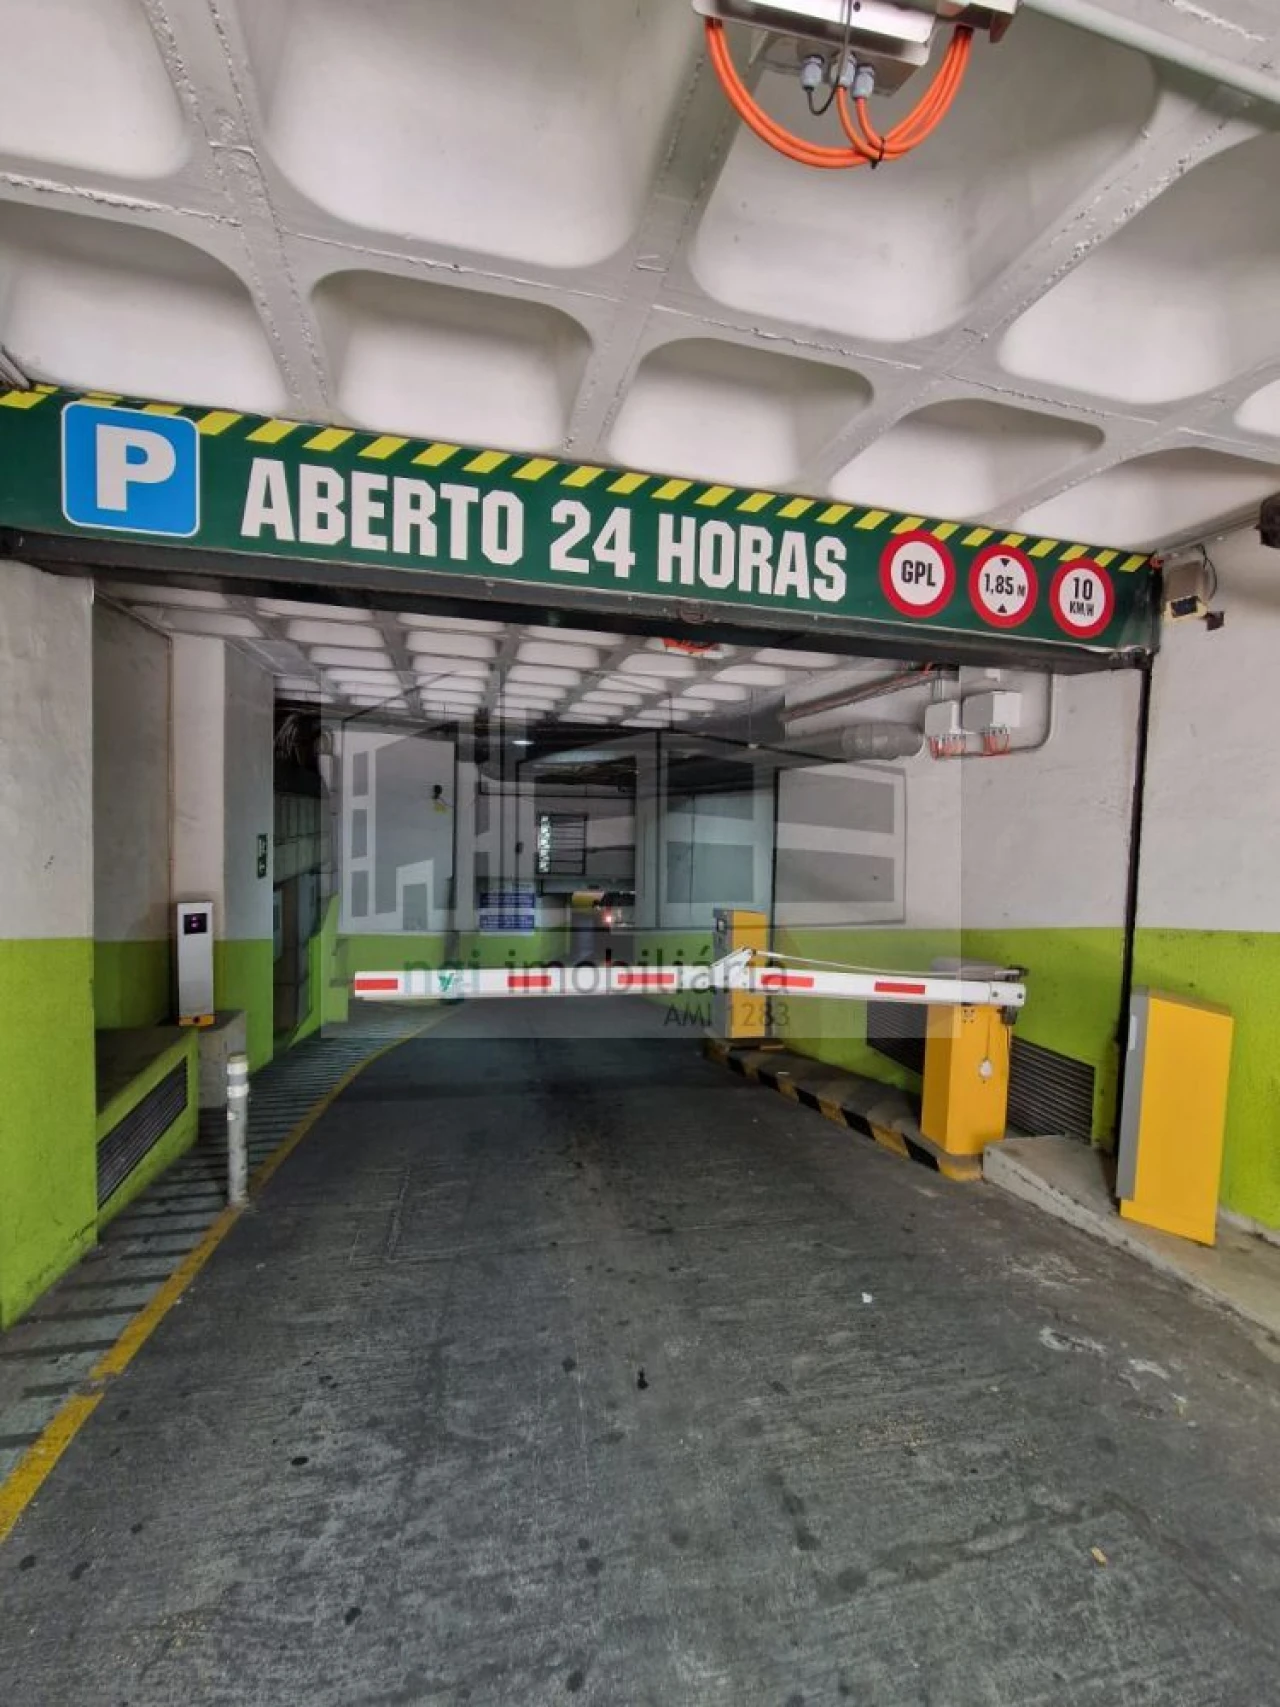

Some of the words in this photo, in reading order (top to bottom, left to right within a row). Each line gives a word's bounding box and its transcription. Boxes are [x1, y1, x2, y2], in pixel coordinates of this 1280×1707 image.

[96, 424, 177, 512] P
[240, 457, 525, 566] ABERTO
[549, 499, 636, 579] 24
[657, 513, 848, 602] HORAS
[901, 559, 936, 588] GPL
[984, 573, 1014, 595] 1,85
[1073, 577, 1093, 601] 10
